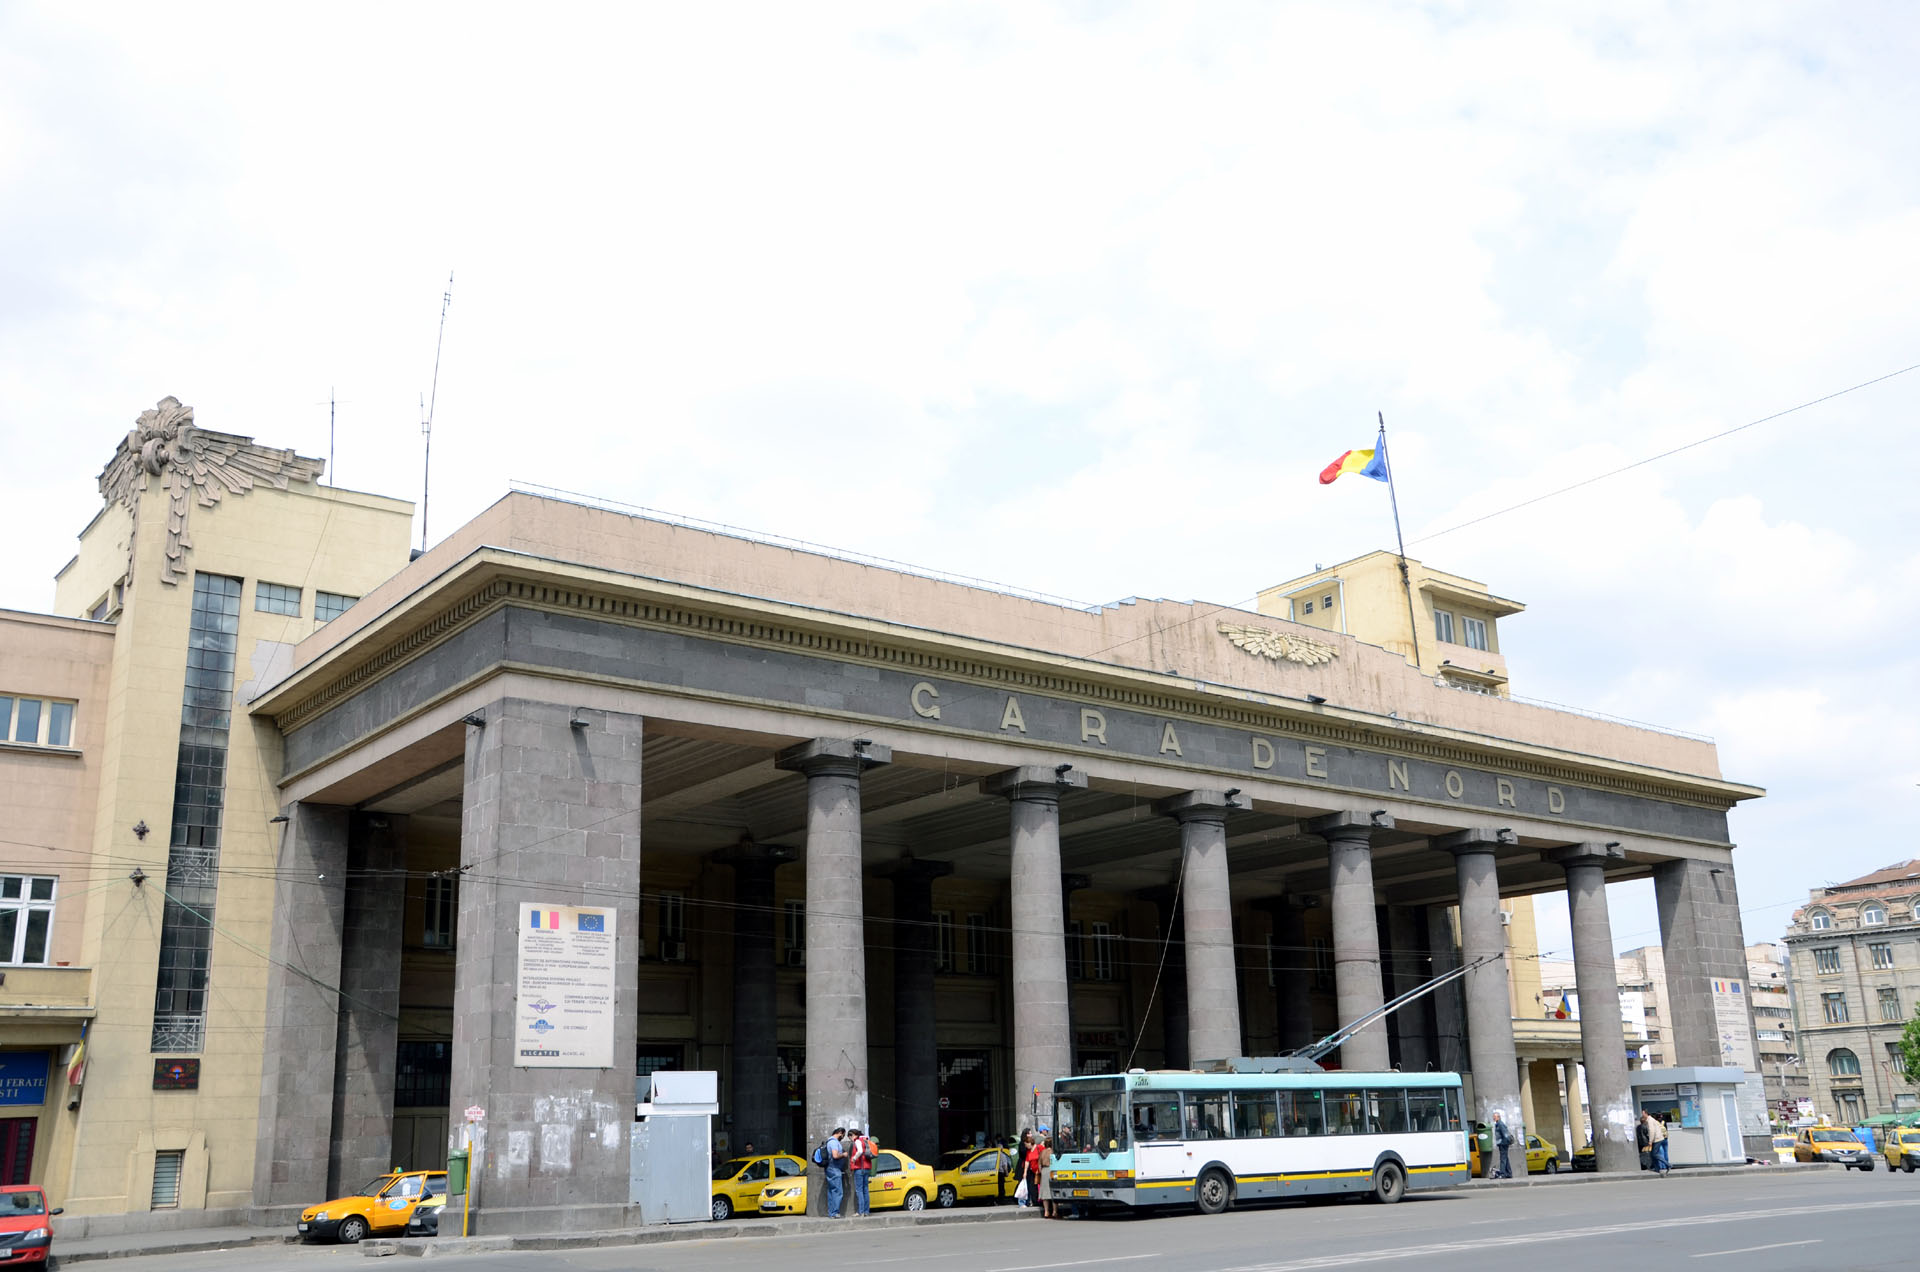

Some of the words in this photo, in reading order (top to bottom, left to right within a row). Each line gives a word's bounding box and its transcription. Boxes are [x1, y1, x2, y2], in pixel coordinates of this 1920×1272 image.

[910, 681, 1183, 757] GARA
[1251, 737, 1328, 778] DE
[1388, 759, 1566, 814] NORD
[6, 1078, 45, 1087] FERATE
